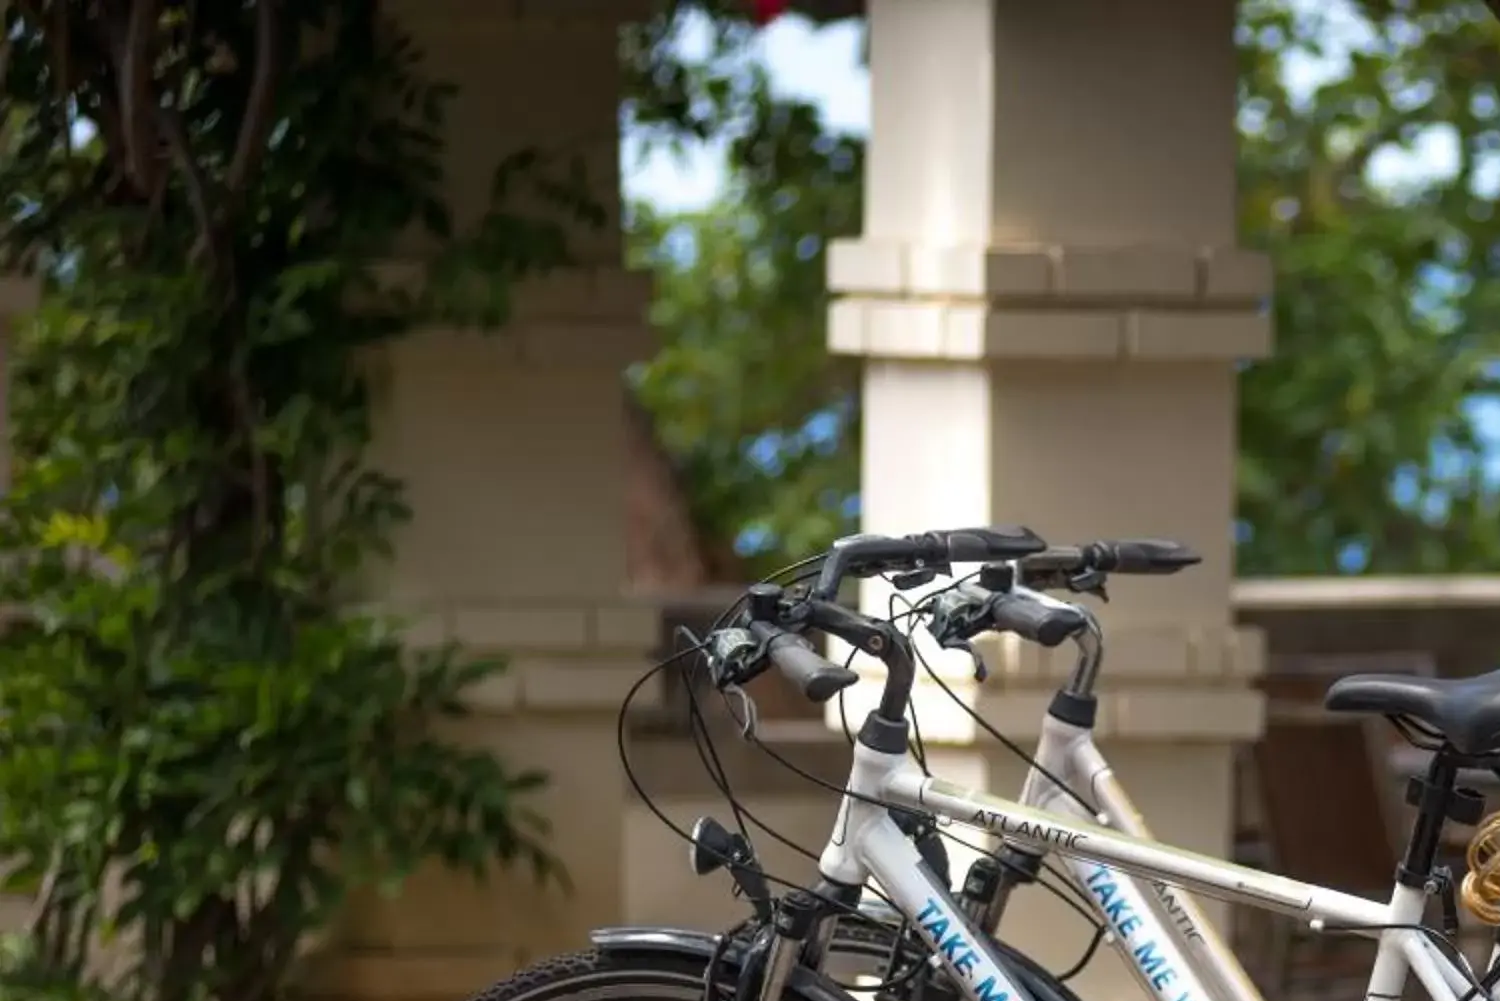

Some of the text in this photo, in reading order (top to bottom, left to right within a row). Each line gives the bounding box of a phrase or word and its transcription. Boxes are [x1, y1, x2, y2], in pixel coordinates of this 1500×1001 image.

[972, 808, 1087, 849] ATLANTIC
[917, 897, 981, 978] TAKE
[1086, 863, 1143, 938] TAKE
[1133, 940, 1178, 991] ME
[1152, 881, 1206, 944] ANTIC
